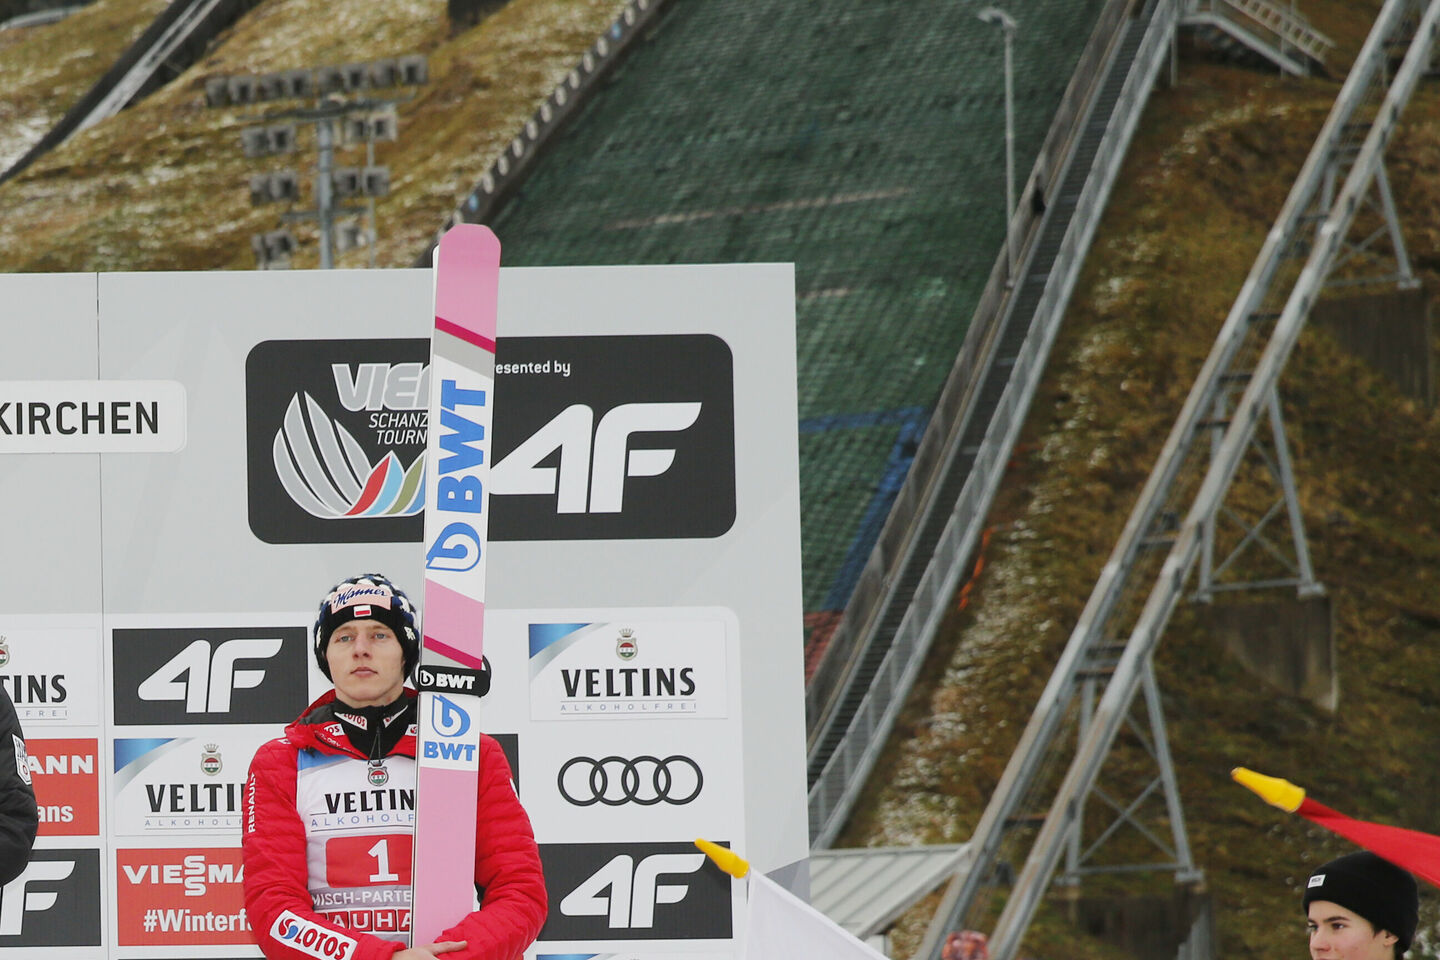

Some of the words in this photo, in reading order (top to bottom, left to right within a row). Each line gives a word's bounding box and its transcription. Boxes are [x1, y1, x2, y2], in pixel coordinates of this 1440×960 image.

[495, 361, 550, 374] esented
[554, 360, 571, 377] by
[332, 362, 430, 412] VIE
[368, 412, 429, 428] SCHANZ
[376, 429, 428, 445] TOURN
[437, 380, 486, 514] BWT
[489, 401, 702, 514] 4F
[333, 588, 388, 608] Manner
[137, 638, 283, 714] 4F
[436, 673, 475, 690] BWT
[560, 667, 696, 698] VELTINS
[560, 702, 697, 712] ALKOHOLFREI
[424, 740, 476, 761] BWT
[145, 784, 246, 813] VELTI
[325, 789, 415, 815] VELTIN
[145, 819, 243, 827] ALKOHOLF
[311, 814, 414, 827] ALKOHOLF
[368, 839, 399, 883] 1
[122, 855, 247, 897] VIESSM
[559, 852, 707, 929] 4F
[294, 925, 351, 960] LOTOS
